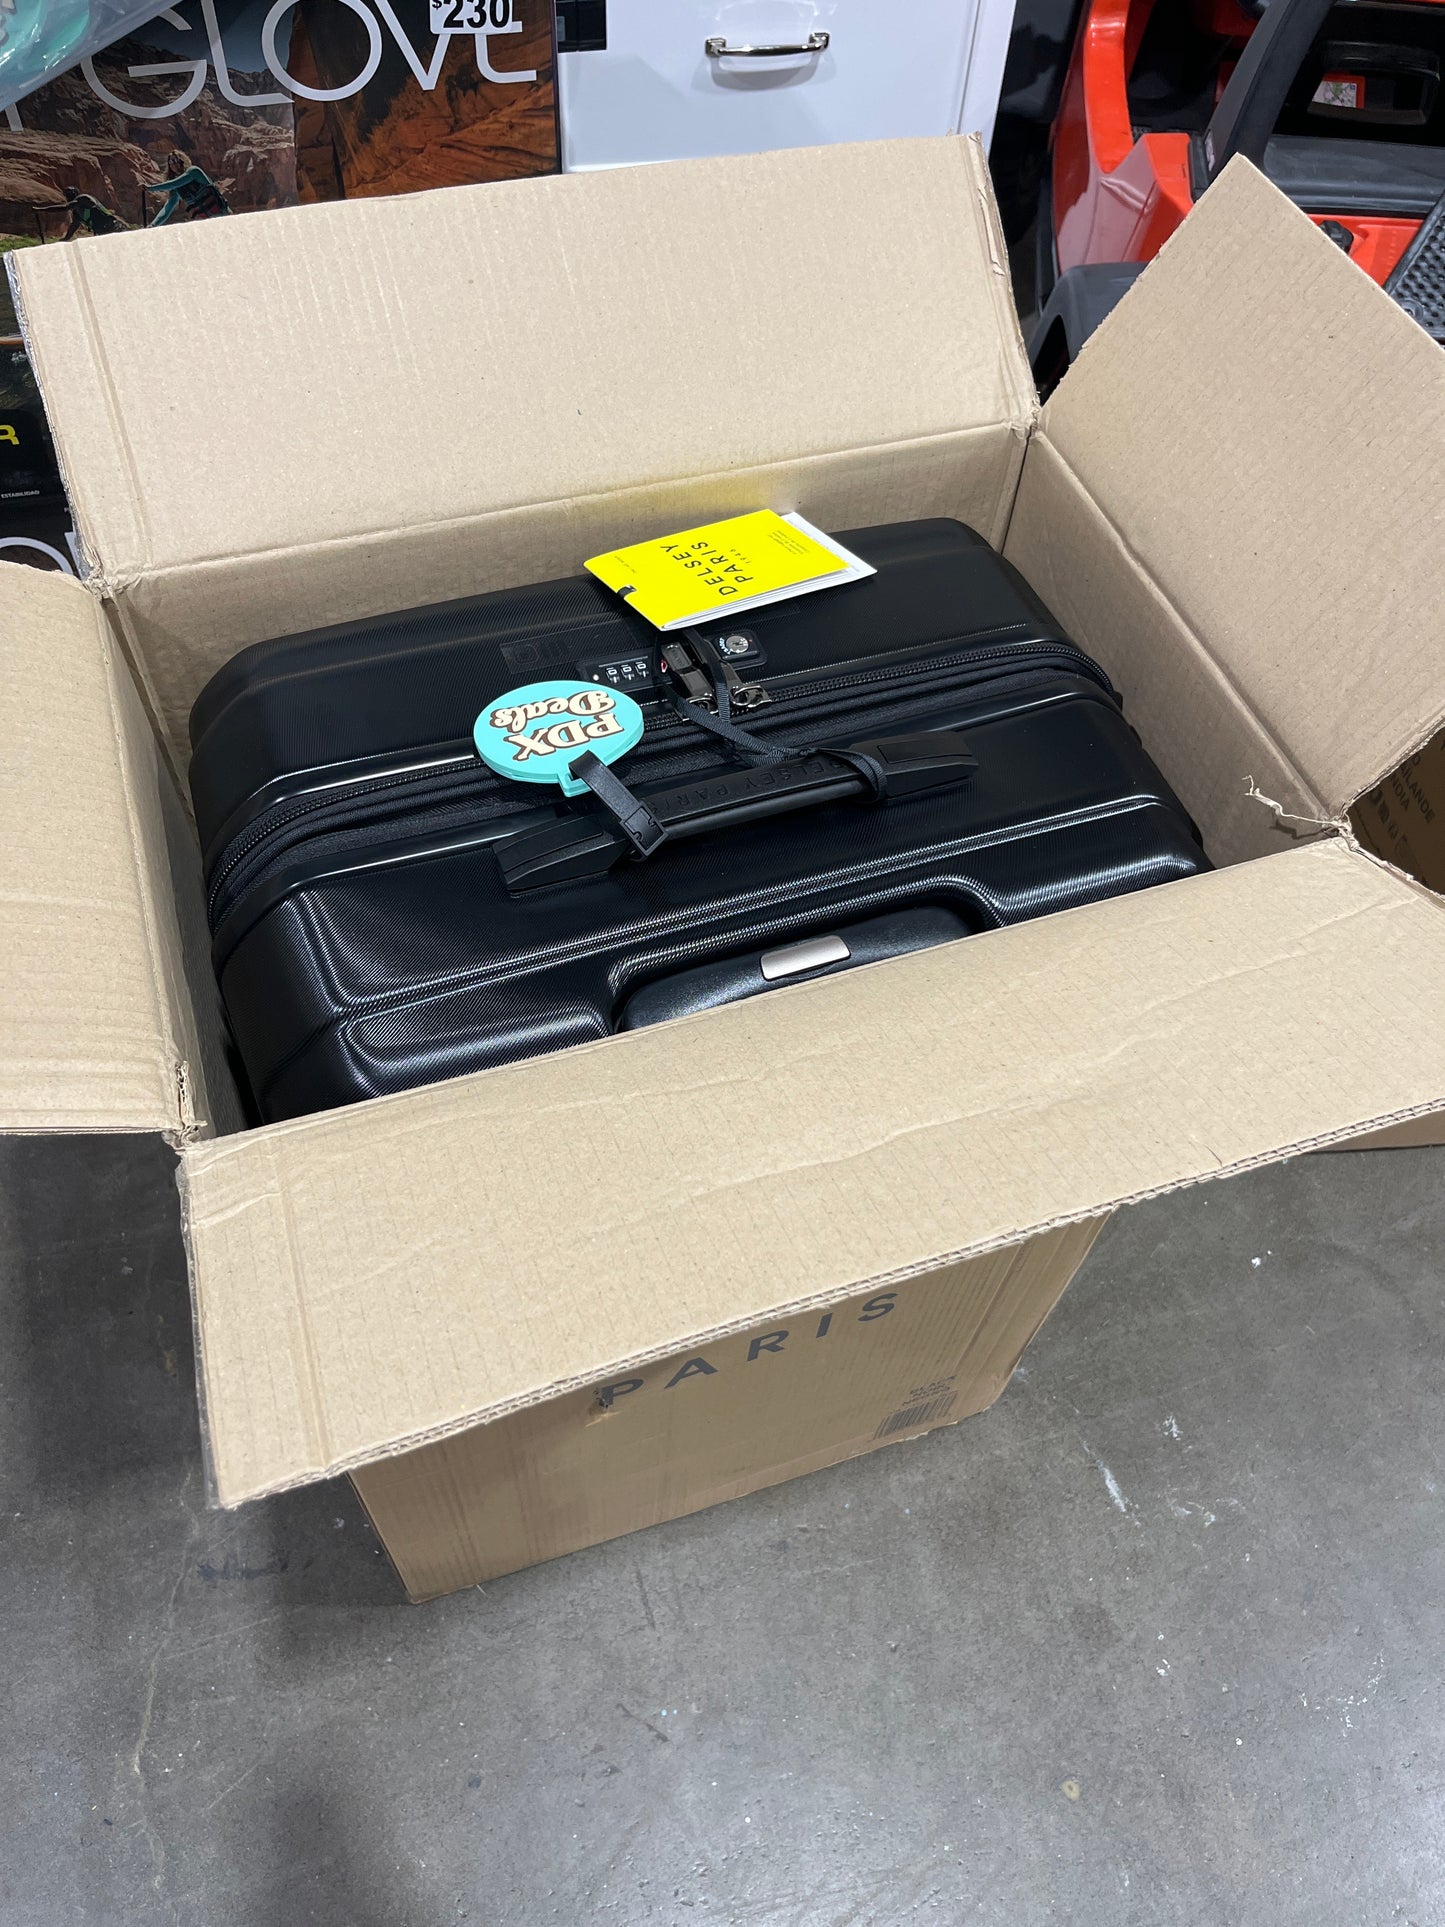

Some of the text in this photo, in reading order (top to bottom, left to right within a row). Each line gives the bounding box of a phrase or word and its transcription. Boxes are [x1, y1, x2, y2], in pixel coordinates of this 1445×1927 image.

[432, 0, 510, 29] $230
[1, 490, 40, 499] ESTABILIDAD
[660, 544, 738, 596] DELSEY
[691, 541, 754, 584] PARIS
[489, 690, 617, 733] Deals
[503, 712, 625, 761] PDX
[599, 1292, 898, 1408] PARIS
